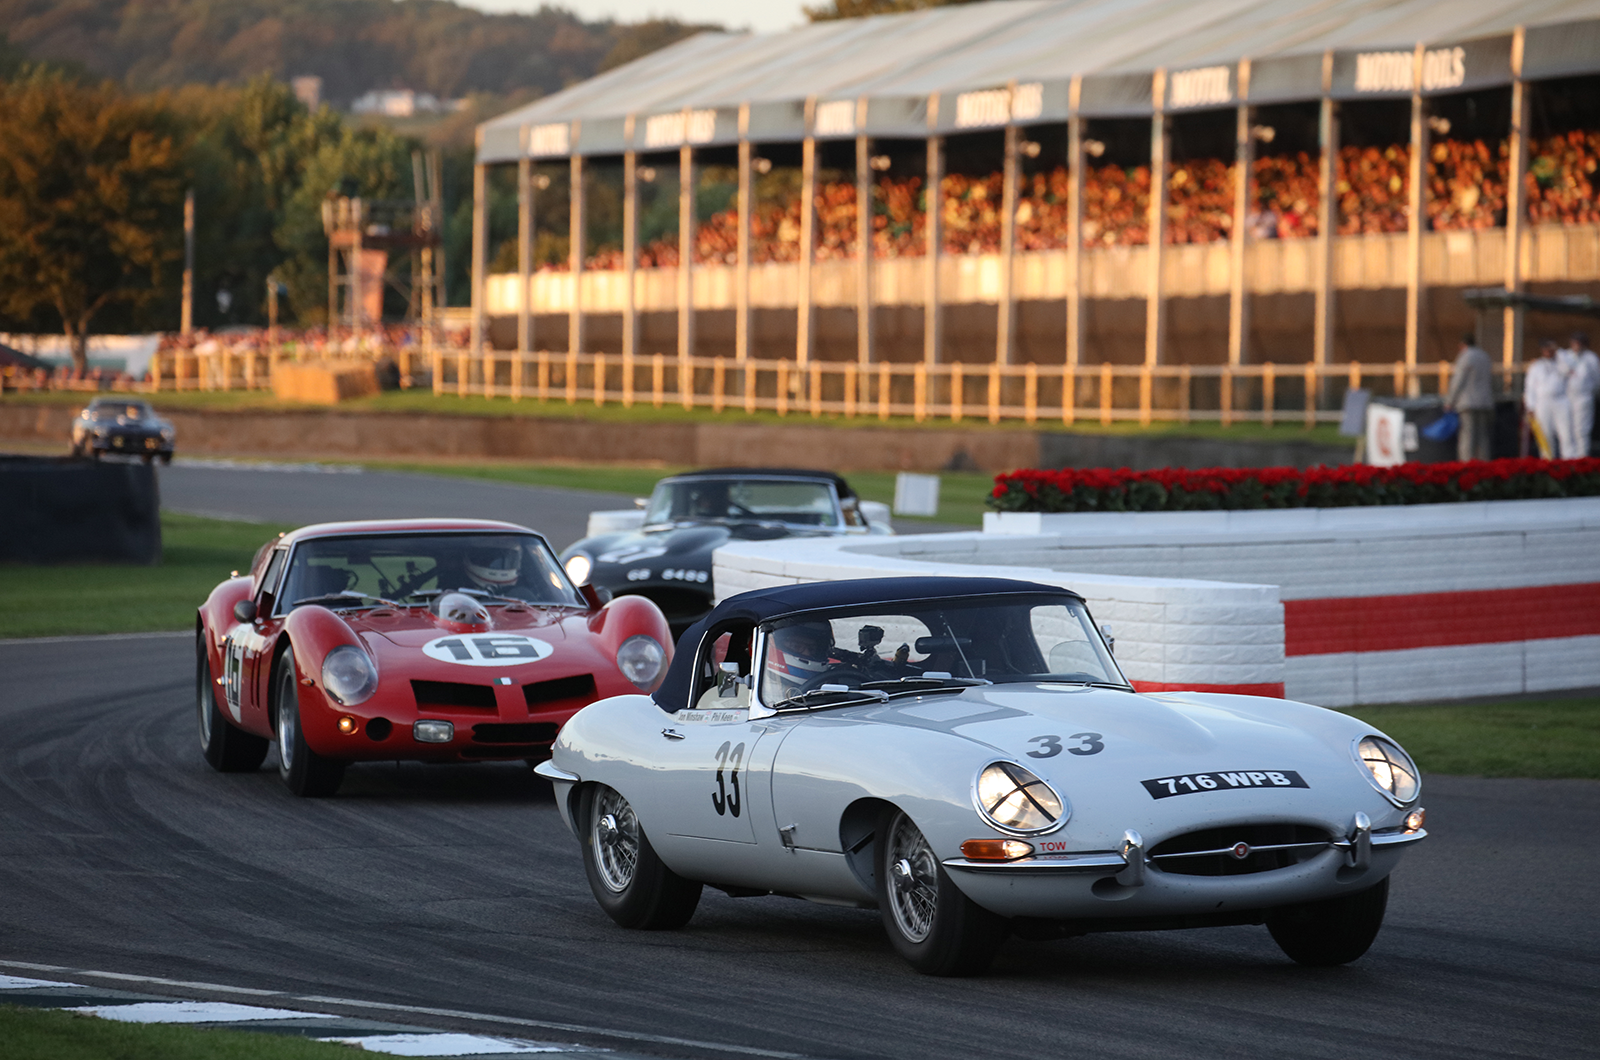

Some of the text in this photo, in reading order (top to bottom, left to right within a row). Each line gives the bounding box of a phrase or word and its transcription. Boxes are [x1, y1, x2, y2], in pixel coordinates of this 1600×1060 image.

[434, 637, 540, 661] 16
[1026, 732, 1105, 759] 33
[712, 741, 745, 818] 33
[1157, 770, 1292, 794] 716 WPB
[1039, 841, 1066, 851] TOW
